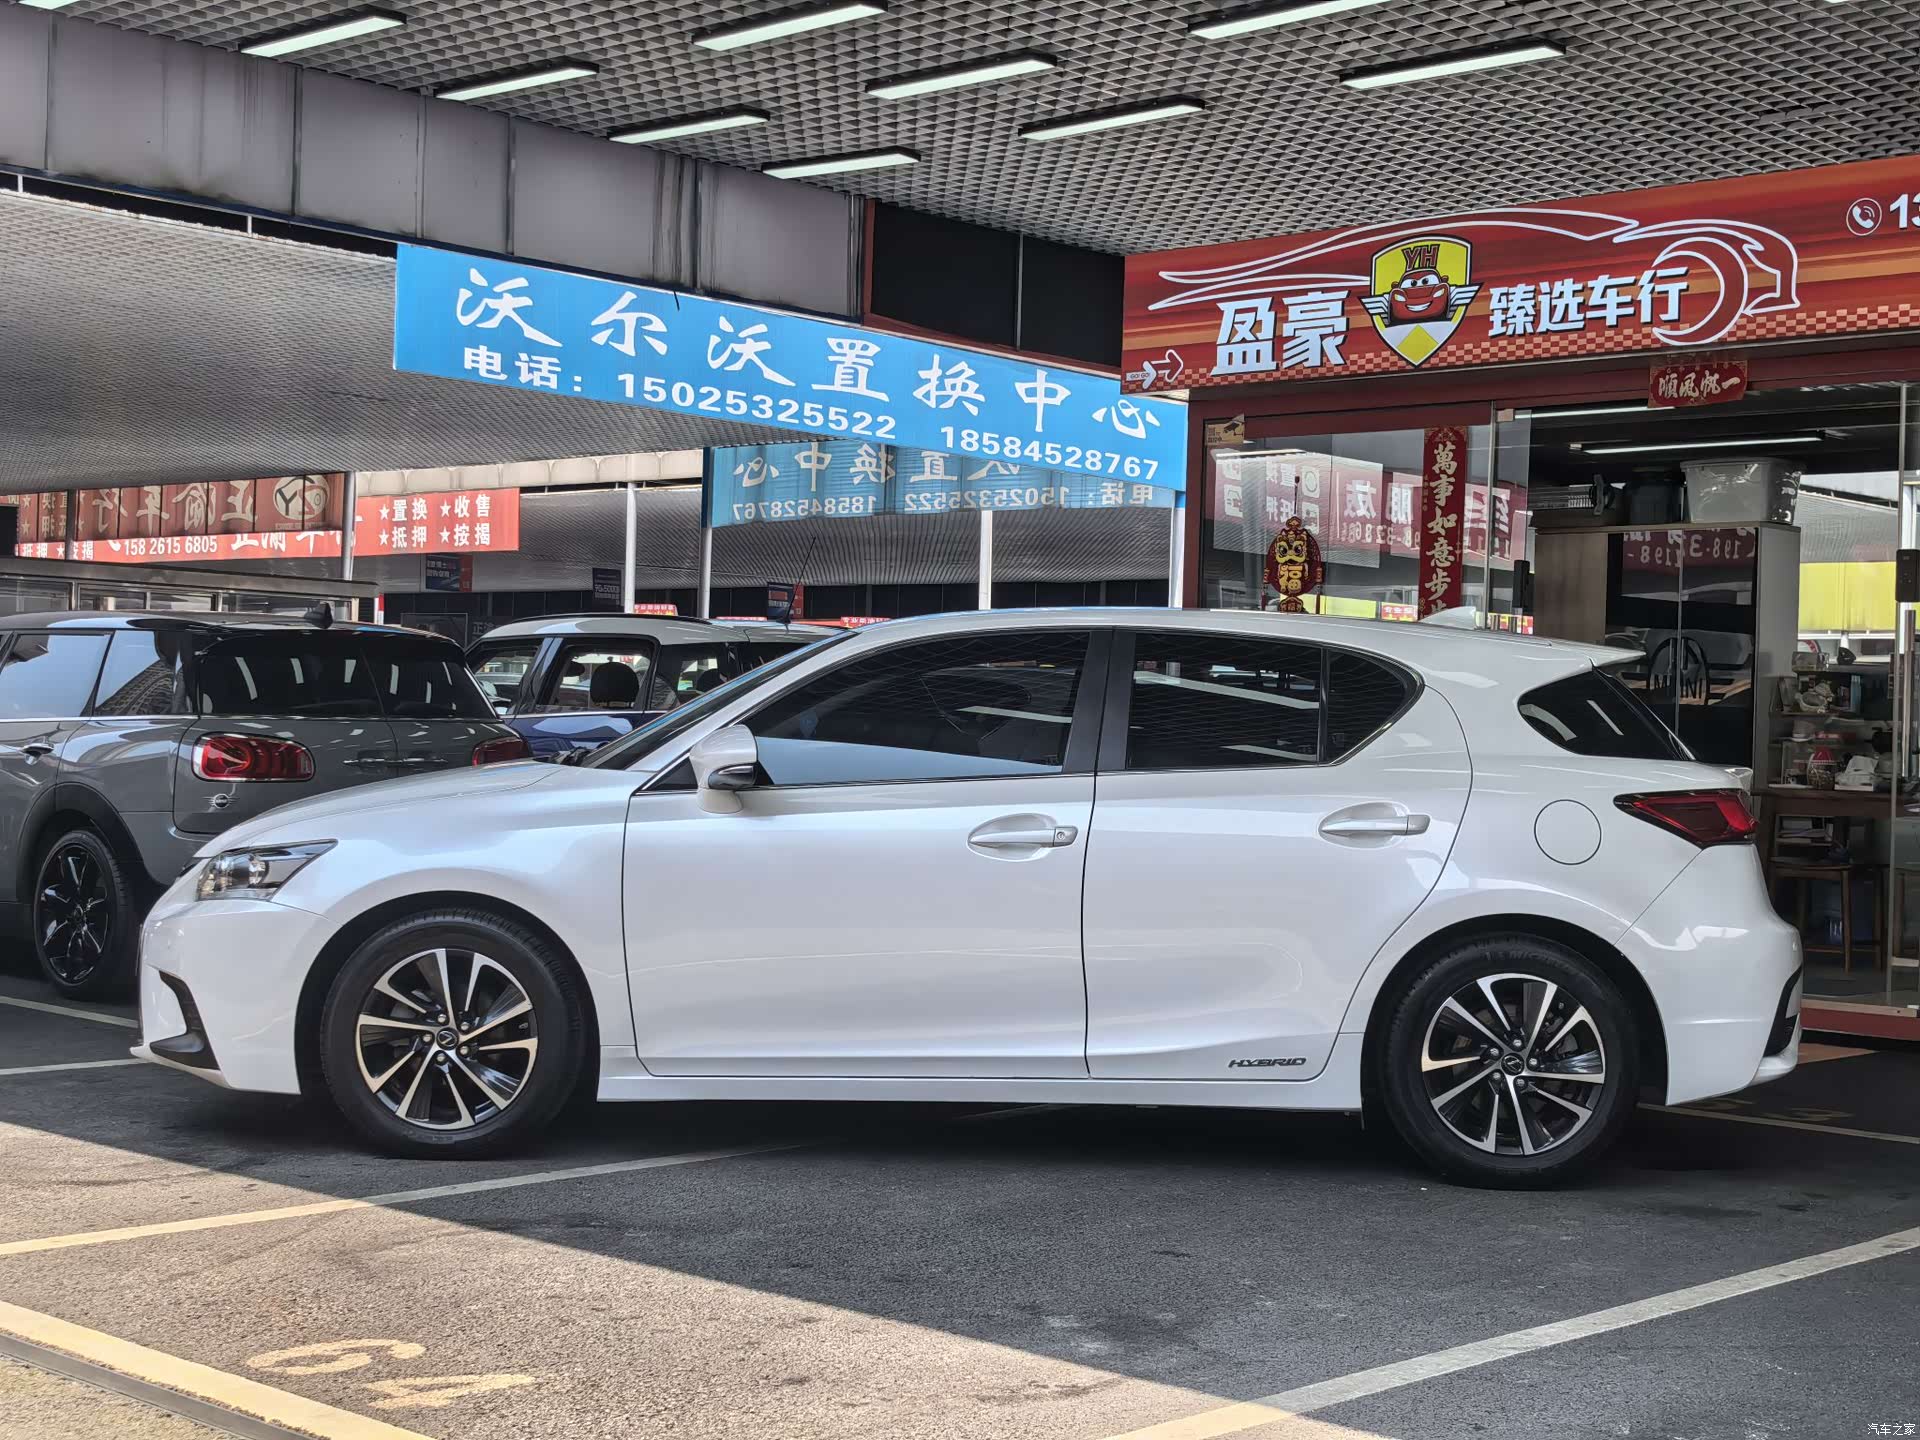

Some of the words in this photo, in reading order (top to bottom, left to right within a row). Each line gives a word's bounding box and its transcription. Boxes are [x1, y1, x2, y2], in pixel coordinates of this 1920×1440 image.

[1401, 244, 1440, 270] YH
[1210, 290, 1350, 376] 盈豪
[1488, 266, 1690, 338] 臻选车行
[456, 268, 1160, 439] 沃尔沃置换中心
[617, 373, 896, 439] 15025325522
[940, 426, 1159, 480] 18584528767
[392, 497, 428, 522] 置换
[454, 493, 491, 518] 收售
[125, 539, 146, 556] 158
[149, 538, 181, 555] 2615
[185, 536, 218, 554] 6805
[392, 526, 428, 548] 抵押
[453, 522, 491, 547] 按揭
[1228, 1057, 1307, 1069] HYBRID
